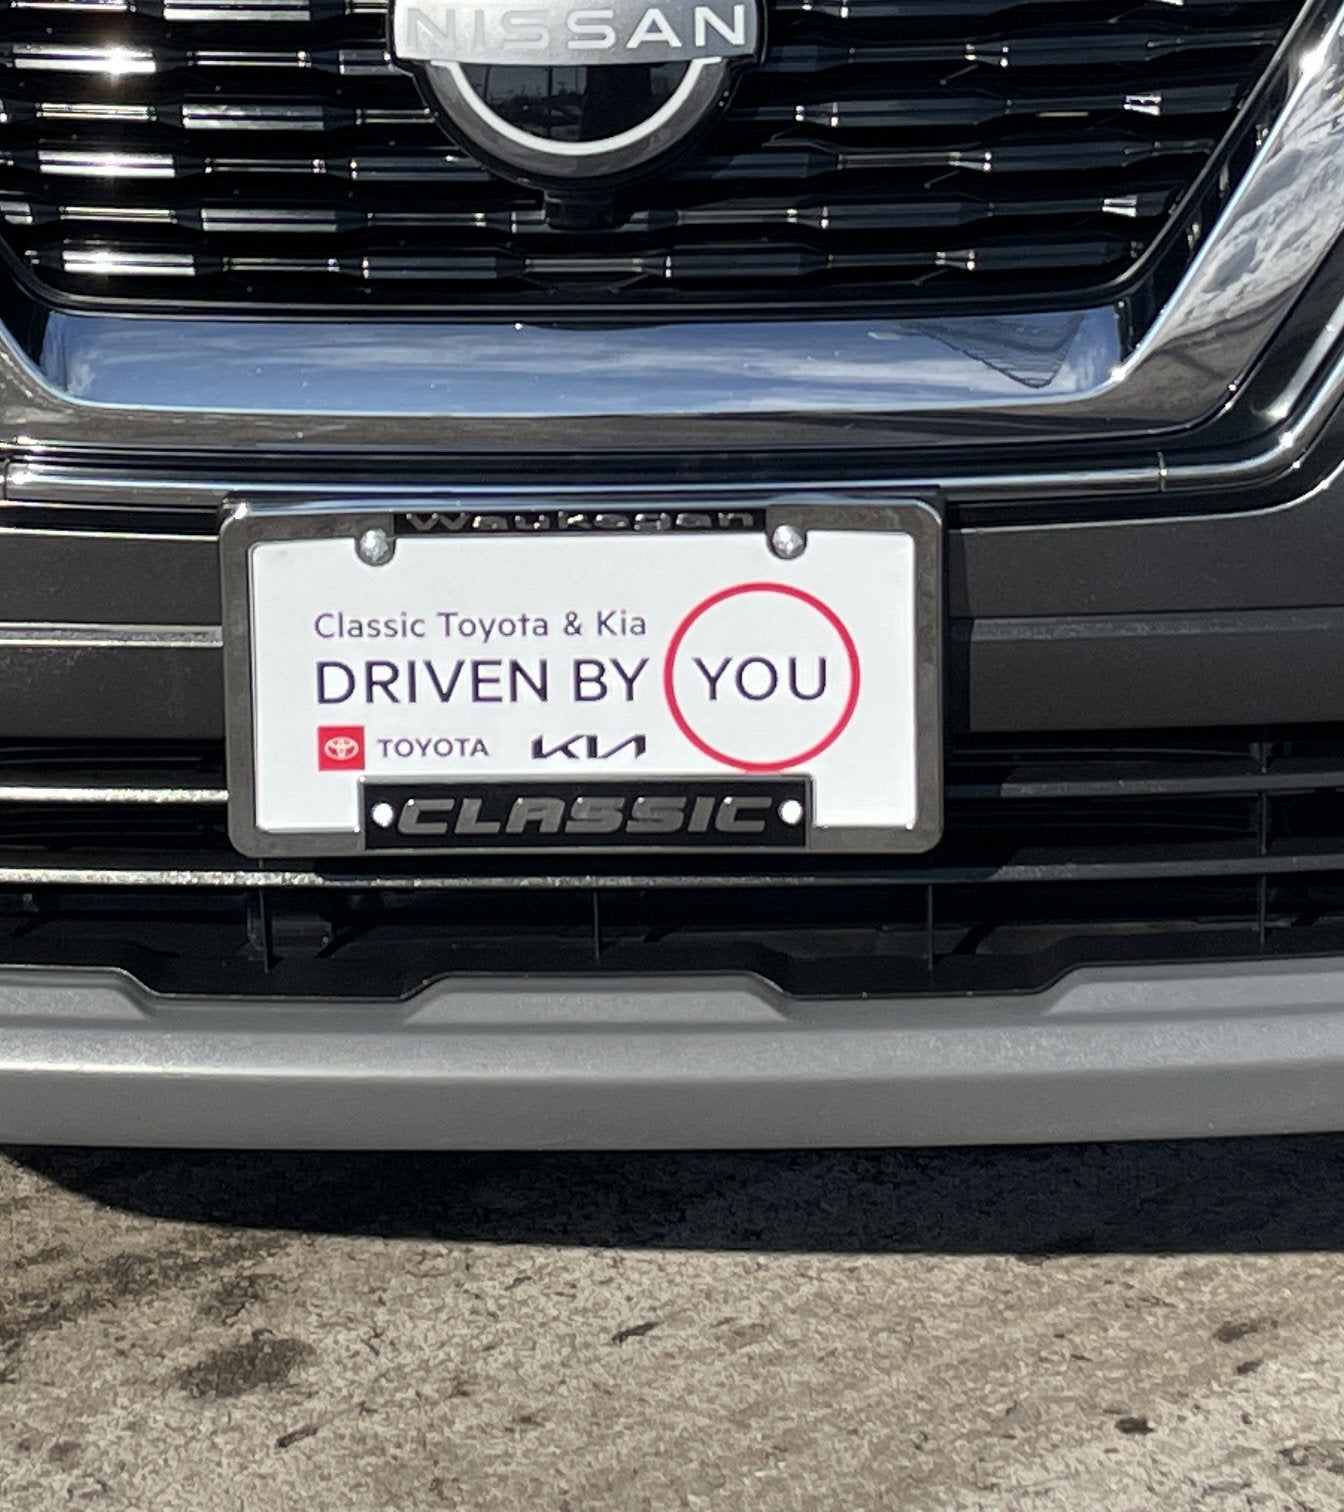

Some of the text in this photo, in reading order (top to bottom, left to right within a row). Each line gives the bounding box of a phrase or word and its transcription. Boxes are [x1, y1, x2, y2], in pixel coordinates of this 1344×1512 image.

[407, 4, 746, 52] NISSAN
[314, 609, 647, 642] Classic Toyota & Kia
[316, 656, 827, 704] DRIVEN BY YOU
[377, 737, 490, 758] TOYOTA
[397, 796, 773, 835] CLASSIC
